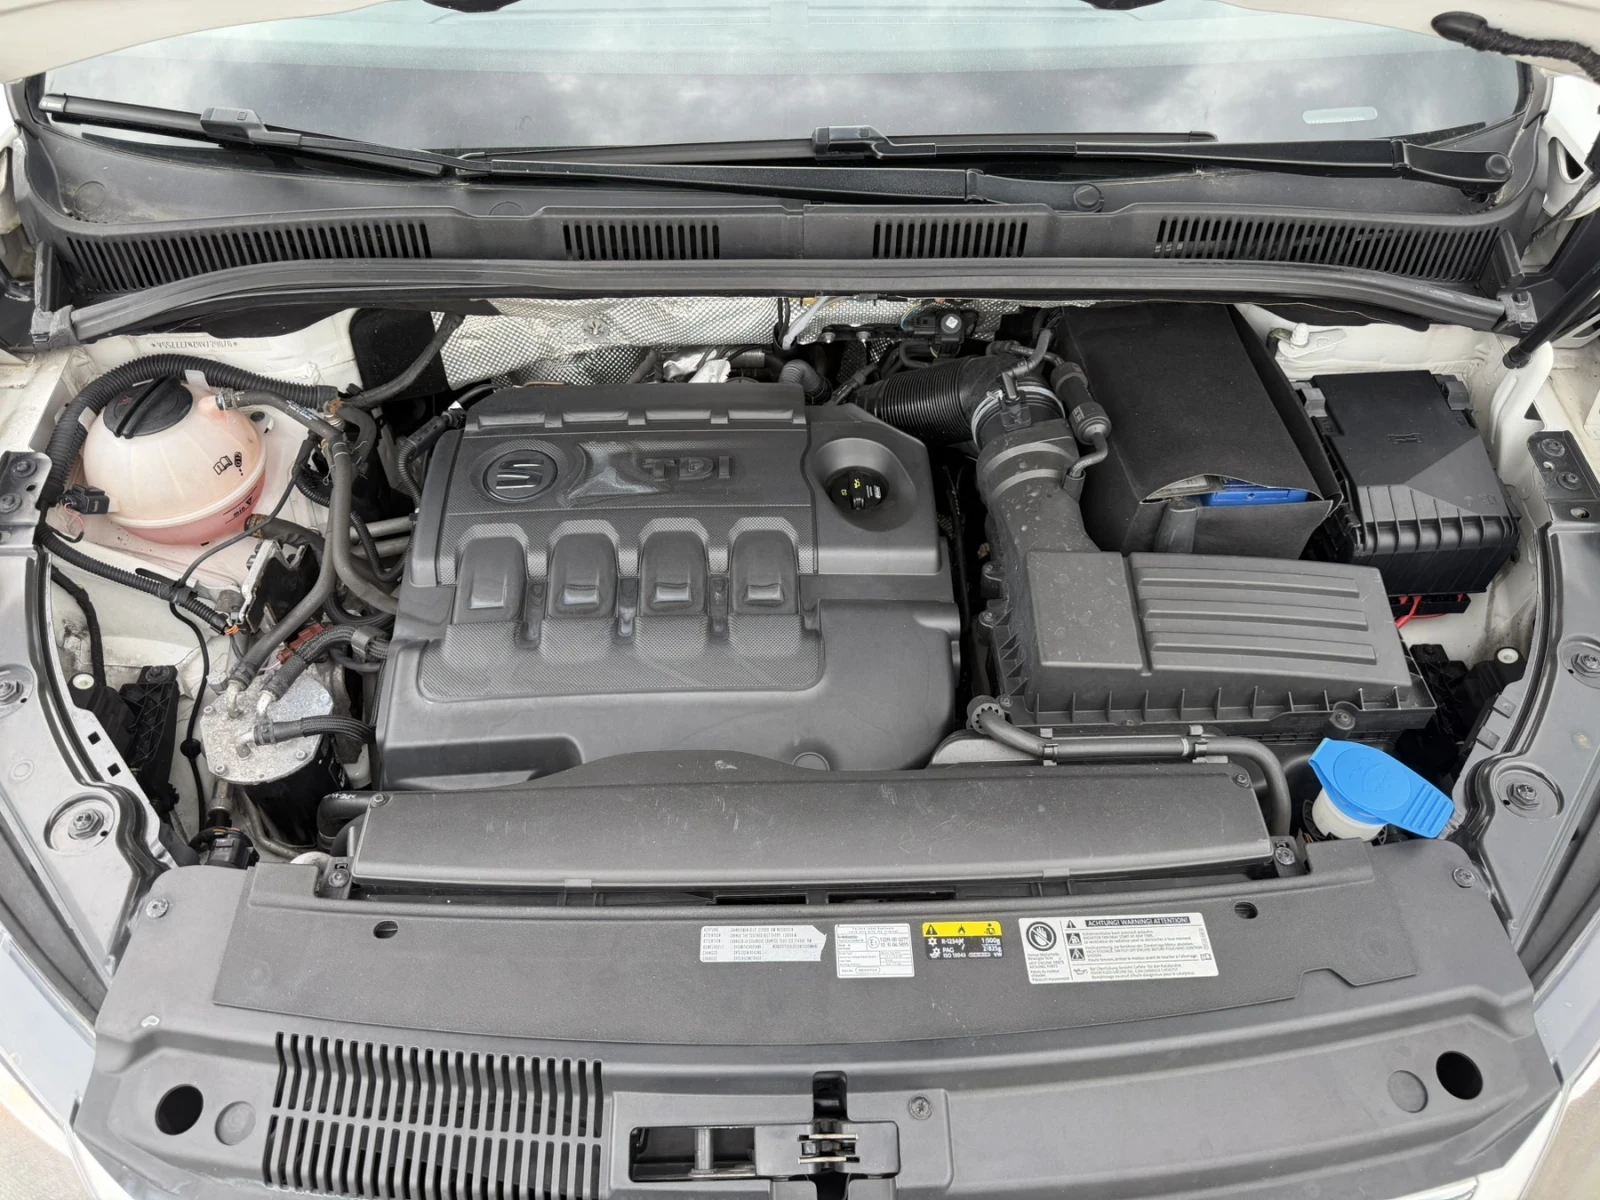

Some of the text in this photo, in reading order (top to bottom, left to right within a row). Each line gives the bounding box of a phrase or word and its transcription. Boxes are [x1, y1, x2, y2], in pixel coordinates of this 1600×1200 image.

[642, 456, 731, 481] TDI
[234, 506, 246, 518] min
[1154, 916, 1188, 924] ATTENTION!
